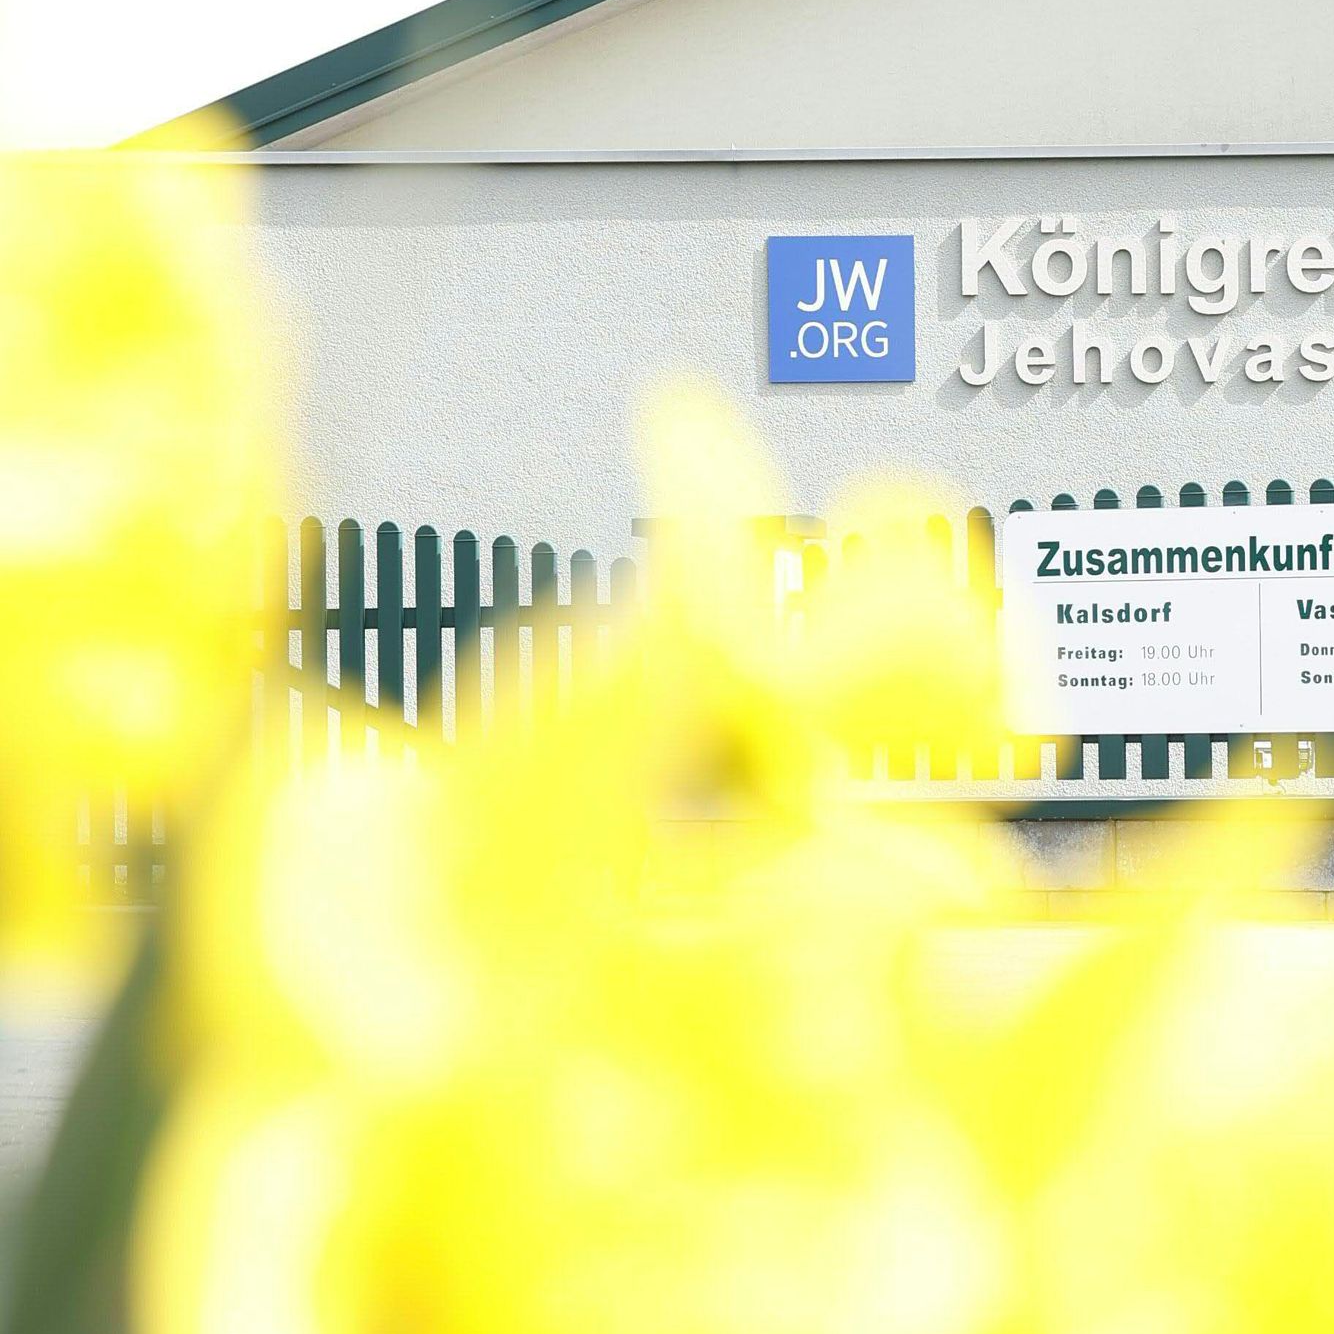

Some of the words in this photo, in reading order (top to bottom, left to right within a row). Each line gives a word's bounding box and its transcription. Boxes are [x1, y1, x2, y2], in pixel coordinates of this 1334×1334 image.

[797, 258, 888, 313] JW
[790, 320, 889, 359] .ORG
[1056, 601, 1172, 625] Kalsdorf
[1057, 646, 1123, 663] Freitag:
[1141, 644, 1181, 660] 19.00
[1188, 644, 1215, 659] Uhr
[1058, 673, 1134, 690] Sonntag:
[1141, 671, 1182, 687] 18.00
[1188, 671, 1215, 686] Uhr
